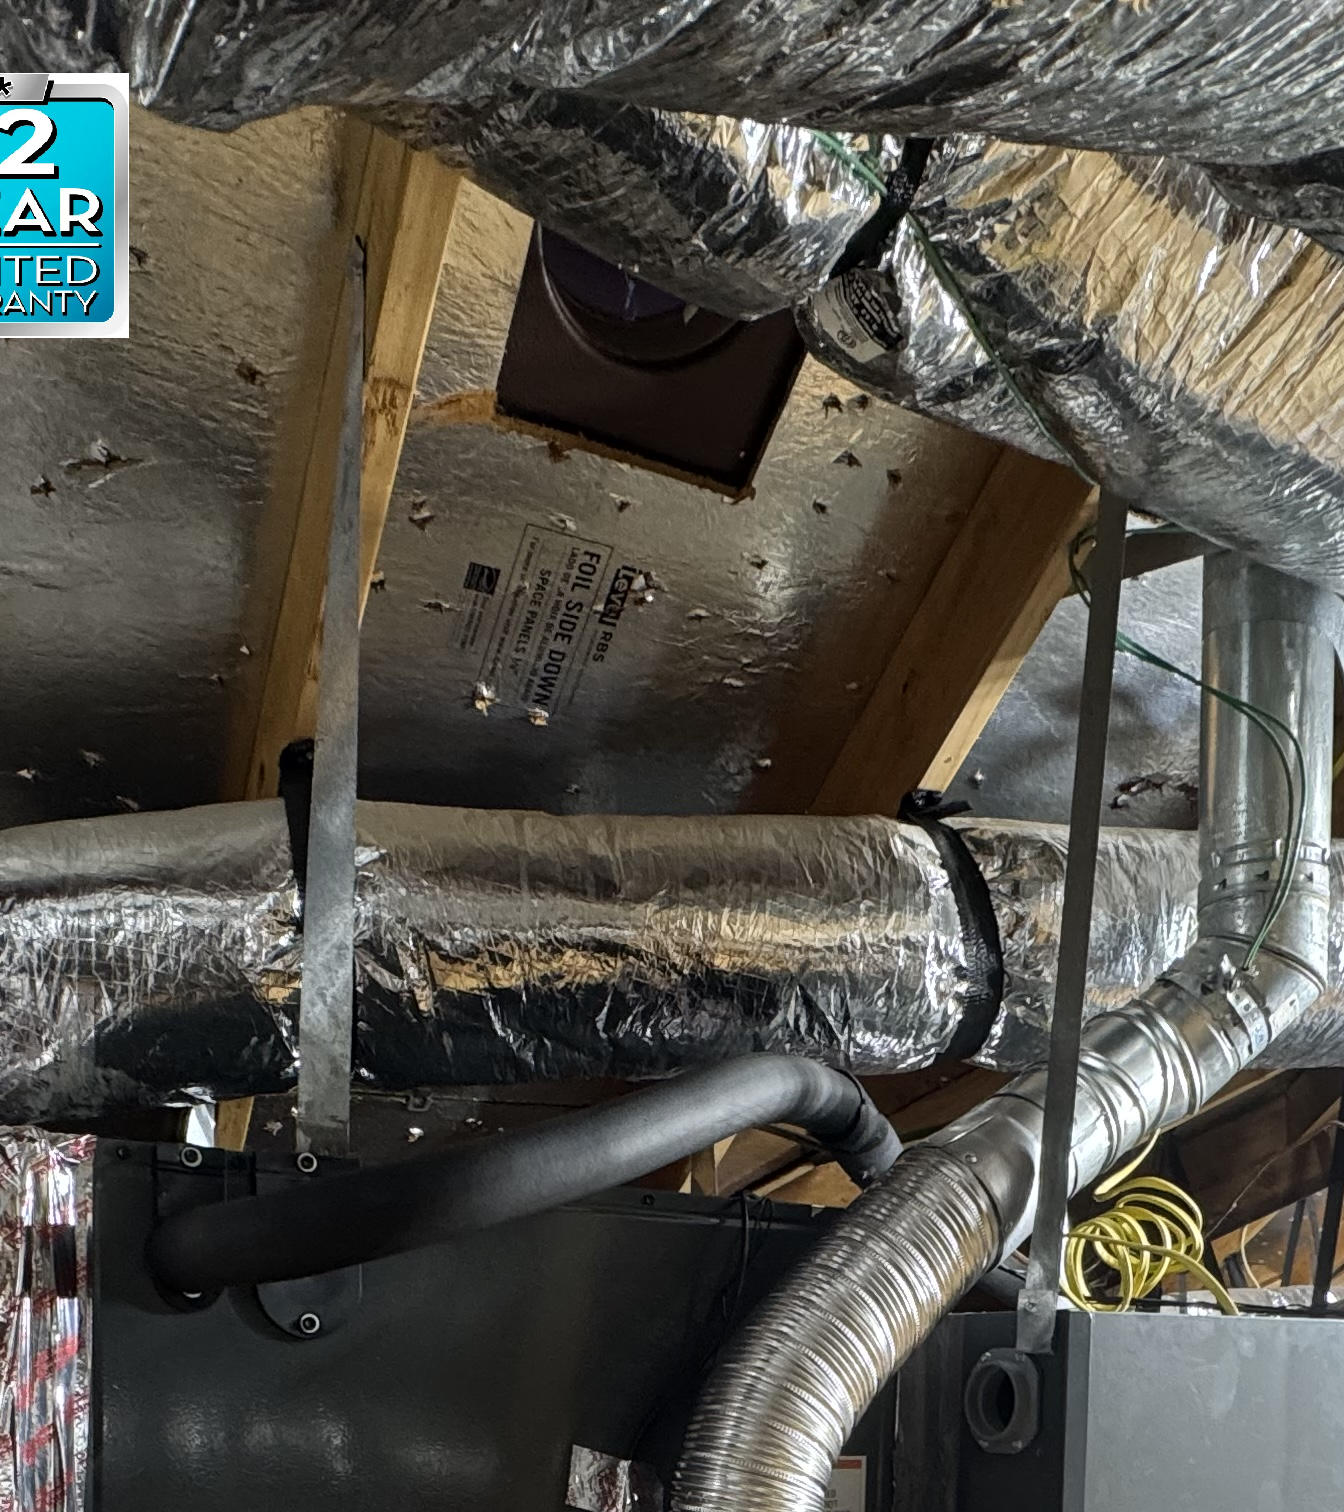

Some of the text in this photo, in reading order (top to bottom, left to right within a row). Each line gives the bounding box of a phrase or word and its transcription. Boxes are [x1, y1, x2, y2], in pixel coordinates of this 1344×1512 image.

[529, 567, 551, 608] SPACE
[571, 549, 601, 596] FOIL
[514, 609, 538, 655] PANELS
[553, 598, 584, 646] SIDE
[592, 630, 613, 664] RBS
[532, 648, 567, 708] DOWN
